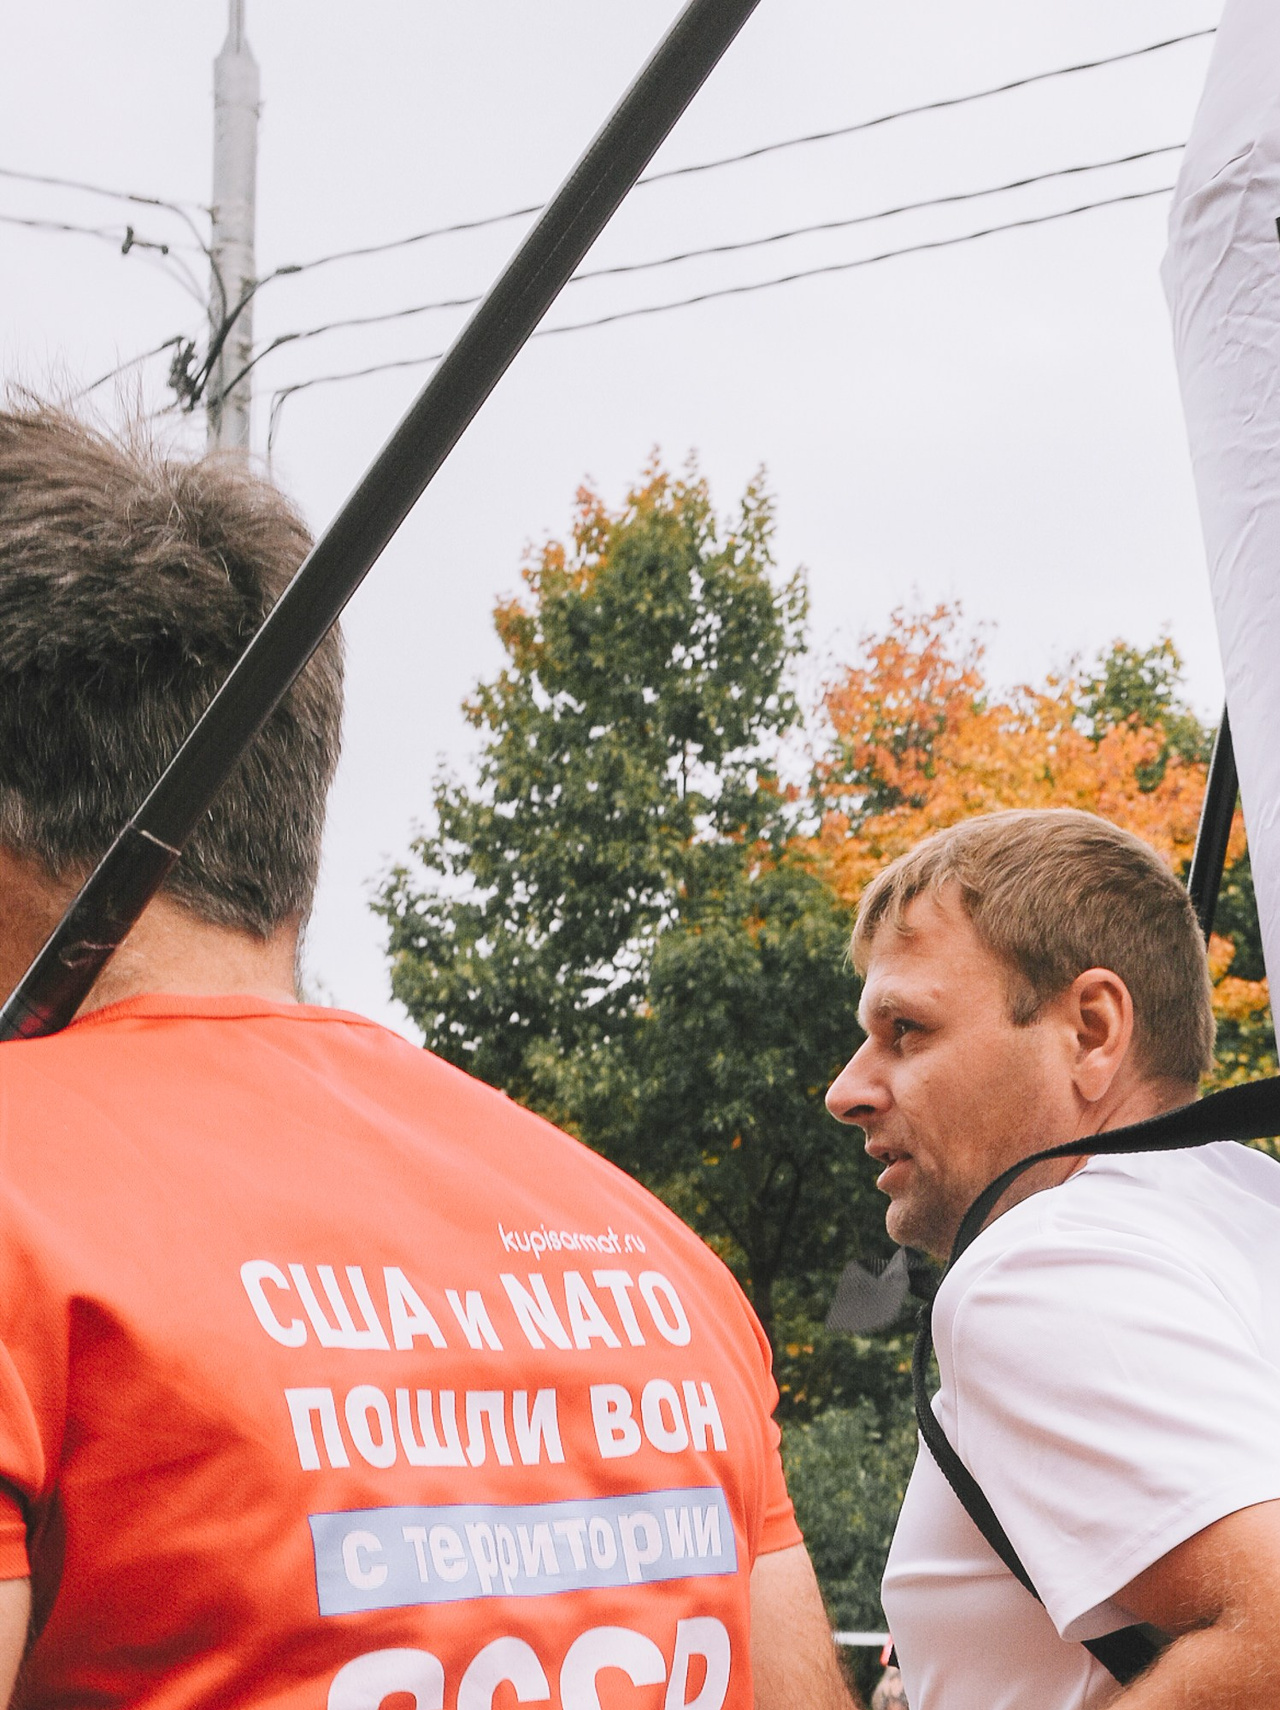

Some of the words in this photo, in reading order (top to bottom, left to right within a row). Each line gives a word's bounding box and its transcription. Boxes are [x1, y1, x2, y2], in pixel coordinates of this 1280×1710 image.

[497, 1222, 646, 1261] kupisarmat.ru
[239, 1258, 447, 1352] США
[499, 1269, 692, 1350] NATO
[284, 1384, 566, 1471] ПОШЛИ
[589, 1378, 728, 1459] ВОН
[341, 1529, 388, 1591] с
[401, 1503, 723, 1595] территории
